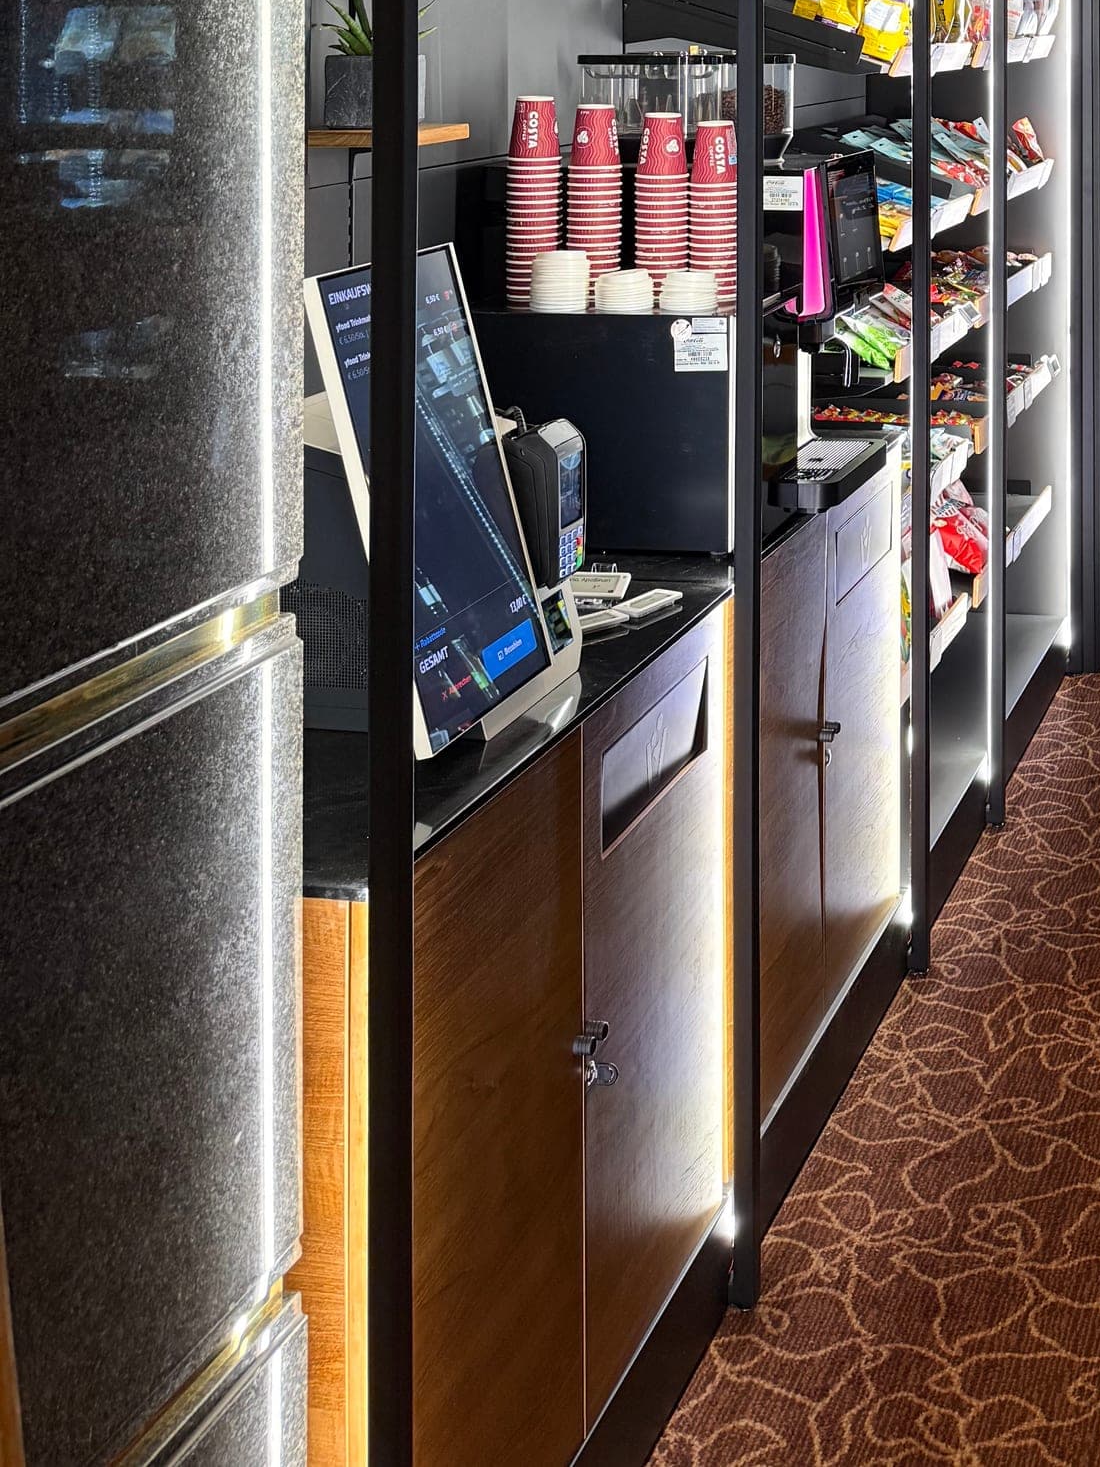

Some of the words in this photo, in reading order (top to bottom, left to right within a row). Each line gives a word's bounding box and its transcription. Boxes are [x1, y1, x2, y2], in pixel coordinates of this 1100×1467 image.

[528, 111, 539, 149] COSTA
[611, 118, 620, 156] COSTA
[639, 127, 650, 165] COSTA
[715, 136, 726, 175] COSTA
[419, 645, 449, 674] GESAMT
